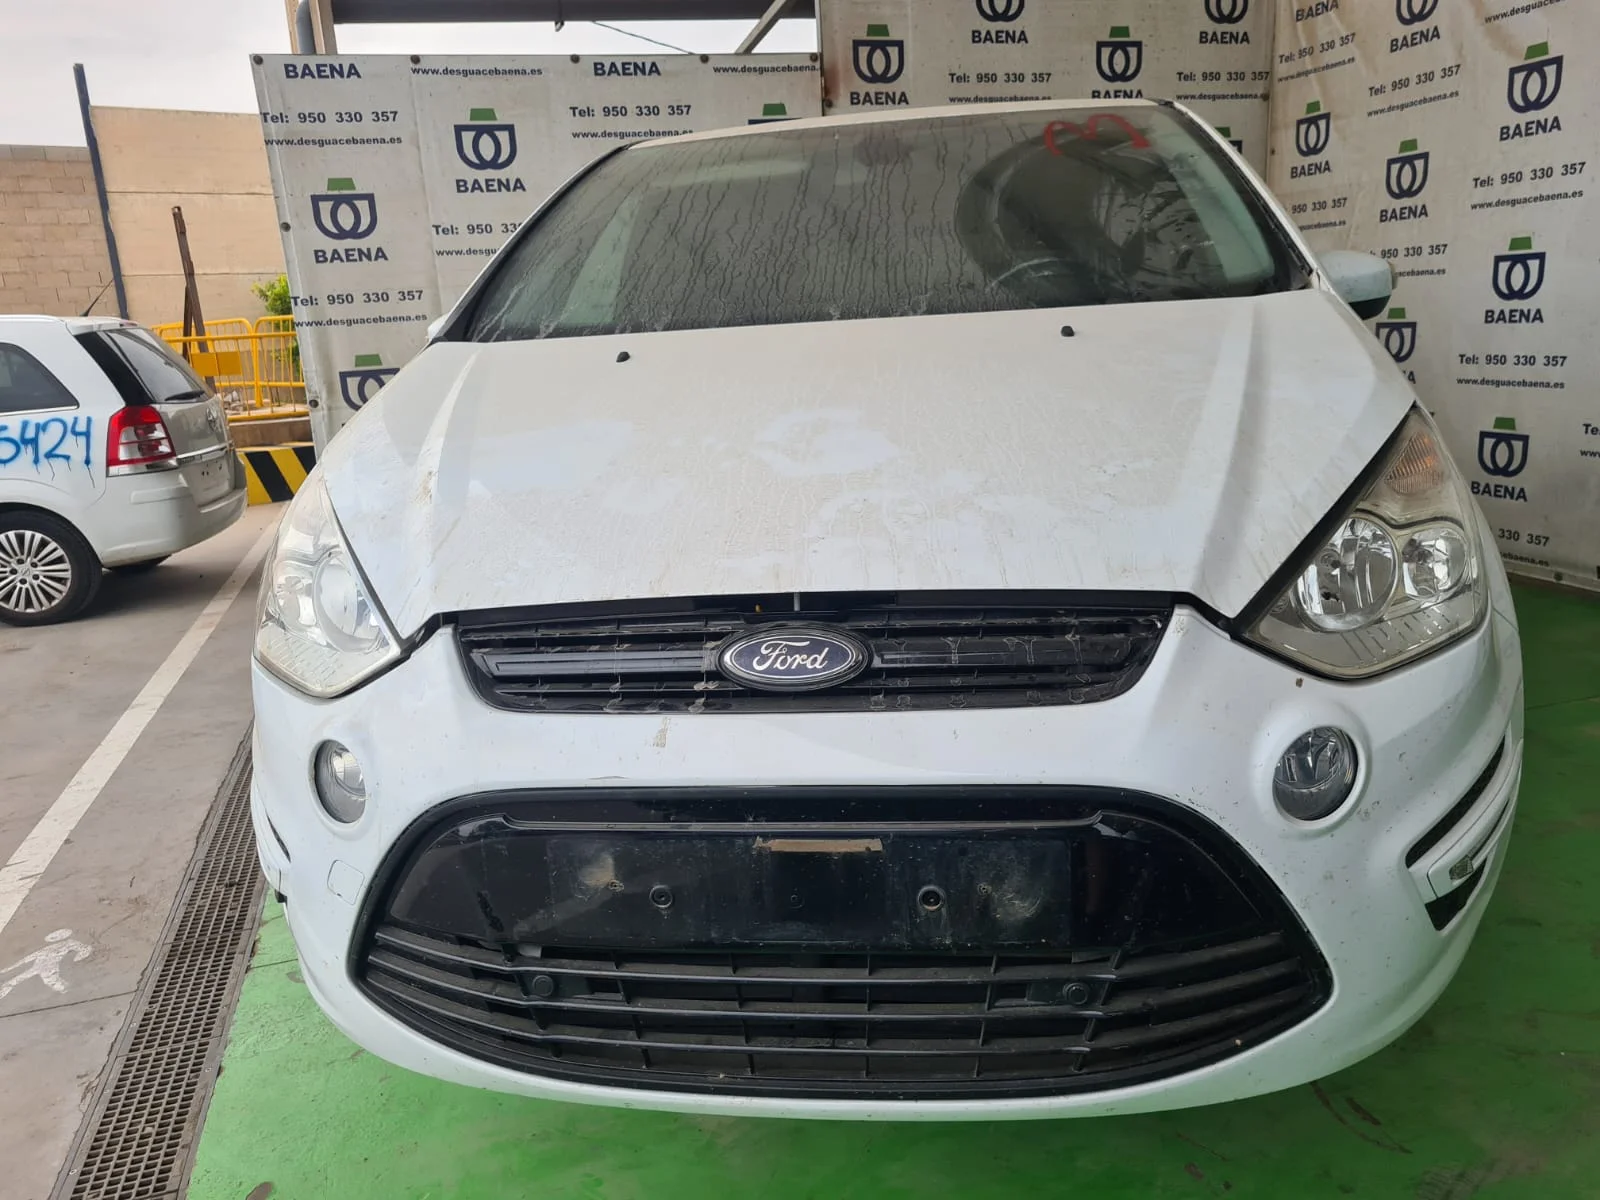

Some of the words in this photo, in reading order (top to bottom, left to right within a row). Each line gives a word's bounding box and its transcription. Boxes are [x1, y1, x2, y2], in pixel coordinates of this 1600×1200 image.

[1296, 0, 1339, 22] BAENA
[971, 30, 1028, 44] BAENA
[1199, 31, 1250, 44] BAENA
[1320, 40, 1335, 53] 330
[1339, 32, 1356, 47] 357
[1390, 25, 1440, 53] BAENA
[284, 63, 361, 79] BAENA
[410, 65, 543, 78] www.desguacebaena.es
[593, 61, 661, 76] BAENA
[949, 73, 970, 83] Tel:
[976, 73, 998, 83] 950
[1004, 73, 1025, 83] 330
[1031, 73, 1052, 83] 357
[1176, 72, 1196, 82] Tel:
[1202, 72, 1221, 82] 950
[1226, 72, 1245, 82] 330
[1251, 72, 1270, 81] 357
[1368, 84, 1386, 97] Tel:
[1391, 77, 1410, 92] 950
[1415, 71, 1435, 85] 330
[1440, 64, 1461, 79] 357
[850, 91, 909, 106] BAENA
[260, 112, 289, 124] Tel:
[298, 112, 326, 124] 950
[335, 111, 363, 123] 330
[371, 110, 399, 122] 357
[569, 106, 595, 118] Tel:
[602, 106, 627, 117] 950
[635, 105, 660, 117] 330
[667, 105, 692, 116] 357
[1499, 116, 1562, 141] BAENA
[264, 135, 403, 147] www.desguacebaena.es
[1290, 160, 1331, 179] BAENA
[1472, 175, 1494, 188] Tel:
[1500, 171, 1523, 185] 950
[1530, 166, 1553, 181] 330
[1561, 161, 1586, 176] 357
[455, 178, 526, 193] BAENA
[1470, 190, 1584, 210] www.desguacebaena.es
[1291, 203, 1308, 214] 950
[1379, 204, 1428, 223] BAENA
[432, 224, 459, 235] Tel:
[467, 223, 493, 235] 950
[314, 246, 388, 264] BAENA
[1381, 248, 1399, 259] 950
[1404, 246, 1422, 258] 330
[1428, 243, 1448, 256] 357
[290, 295, 319, 307] Tel:
[327, 294, 354, 305] 950
[363, 292, 390, 303] 330
[398, 290, 424, 301] 357
[293, 313, 428, 328] www.desguacebaena.es
[1484, 308, 1544, 324] BAENA
[1458, 354, 1479, 365] Tel:
[1485, 354, 1507, 366] 950
[1513, 355, 1536, 366] 330
[1543, 355, 1567, 367] 357
[1456, 376, 1565, 389] www.desguacebaena.es
[1582, 423, 1600, 435] Te
[1471, 480, 1528, 502] BAENA
[1498, 528, 1520, 542] 330
[1526, 533, 1550, 547] 357
[752, 640, 829, 671] Ford
